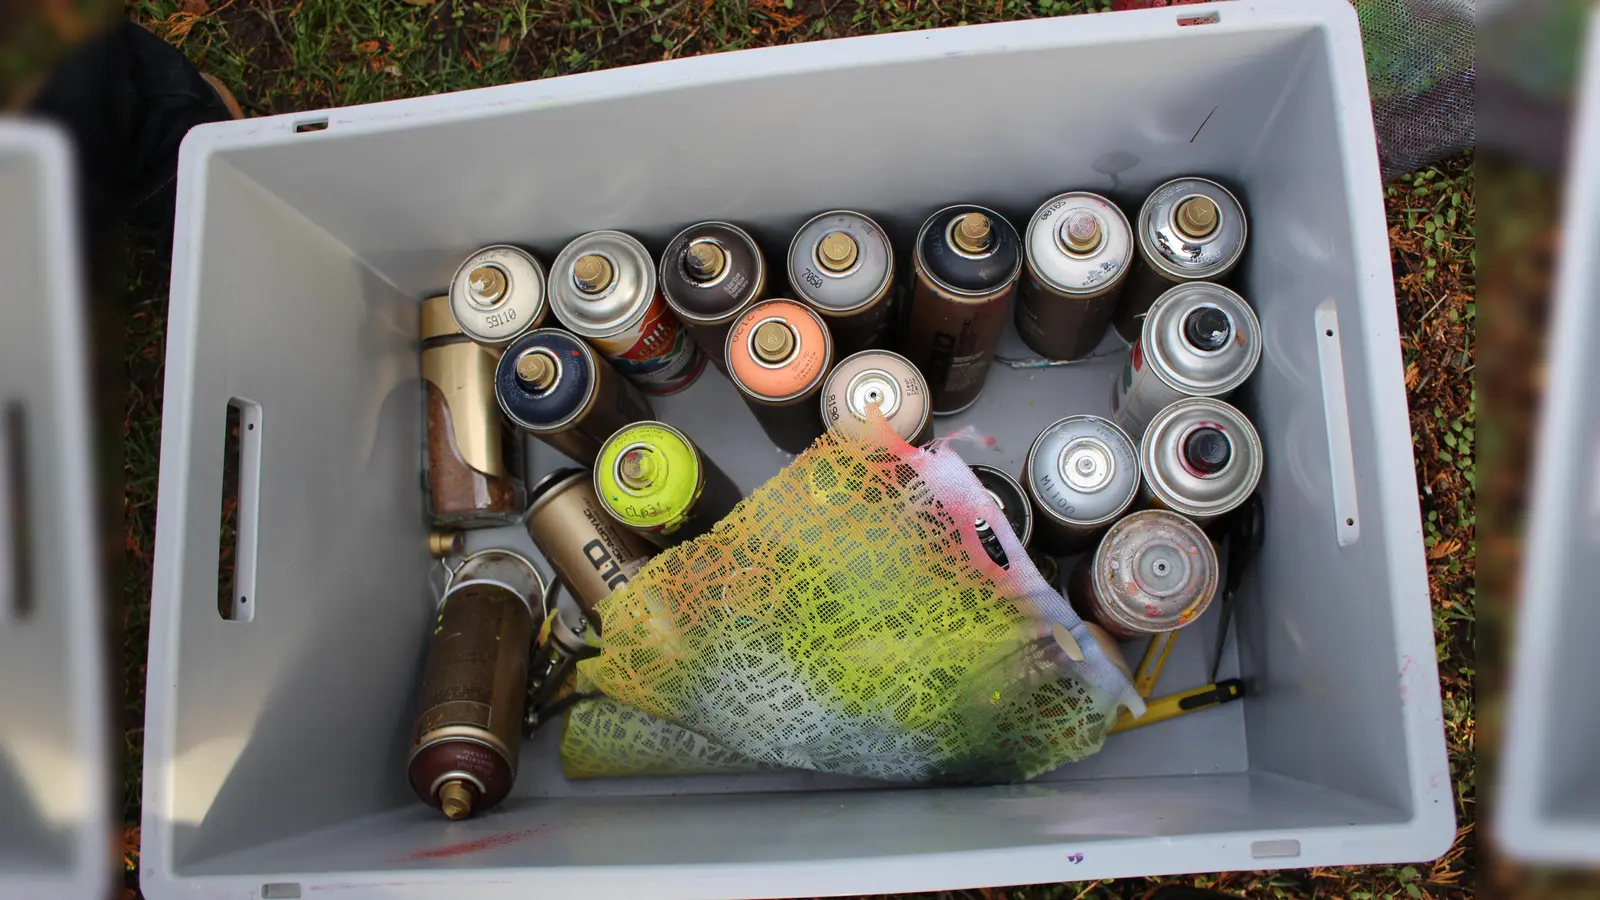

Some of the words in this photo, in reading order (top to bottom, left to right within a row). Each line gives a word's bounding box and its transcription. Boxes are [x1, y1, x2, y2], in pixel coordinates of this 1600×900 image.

[801, 268, 824, 289] 7050
[485, 308, 517, 328] S9110
[828, 394, 840, 421] 8190
[1040, 474, 1076, 516] M1100
[583, 508, 626, 565] NC-ACRYLIC
